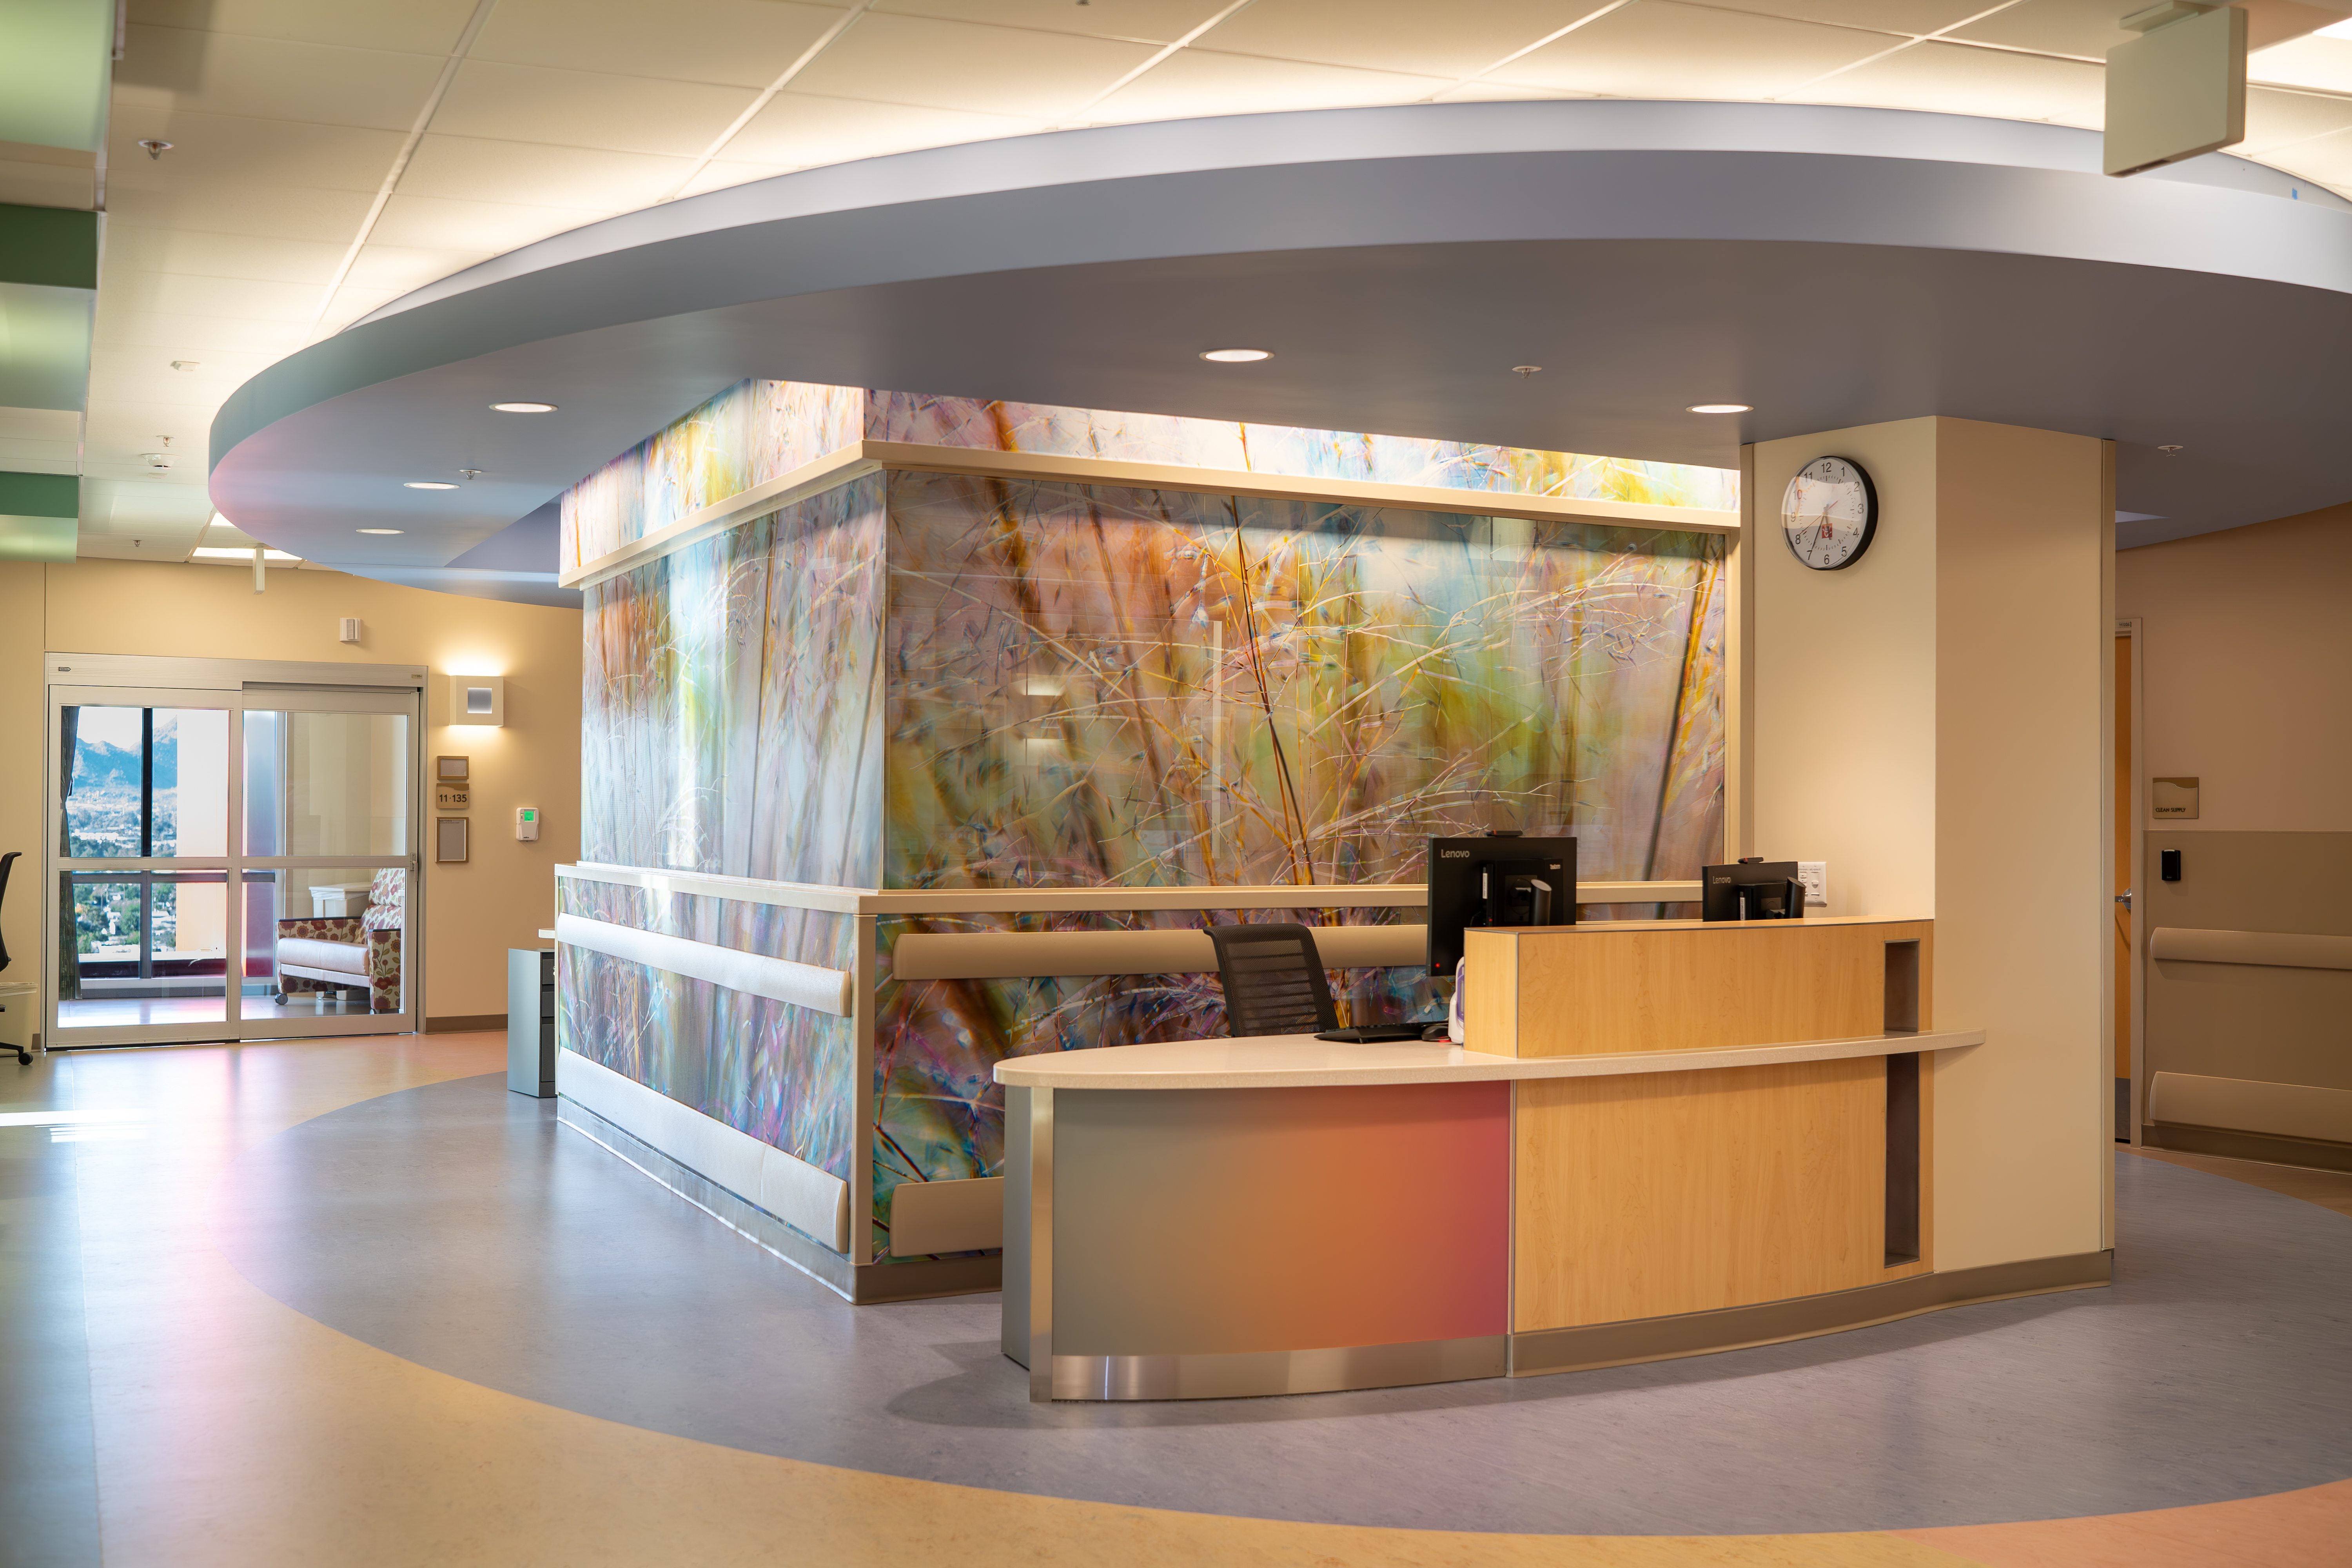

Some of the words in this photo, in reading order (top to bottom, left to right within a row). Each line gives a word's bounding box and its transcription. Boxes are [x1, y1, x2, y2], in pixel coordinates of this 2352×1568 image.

[1821, 462, 1832, 473] 12
[1841, 466, 1845, 477] 1
[1804, 472, 1813, 482] 11
[1853, 481, 1860, 492] 2
[1793, 489, 1802, 500] 10
[1857, 503, 1864, 514] 3
[1790, 512, 1796, 523] 9
[1853, 527, 1859, 538] 4
[1795, 534, 1801, 545] 8
[1806, 550, 1813, 561] 7
[1841, 546, 1847, 557] 5
[1824, 554, 1829, 565] 6
[1441, 849, 1470, 858] Lenovo
[1712, 876, 1731, 884] Lenovo
